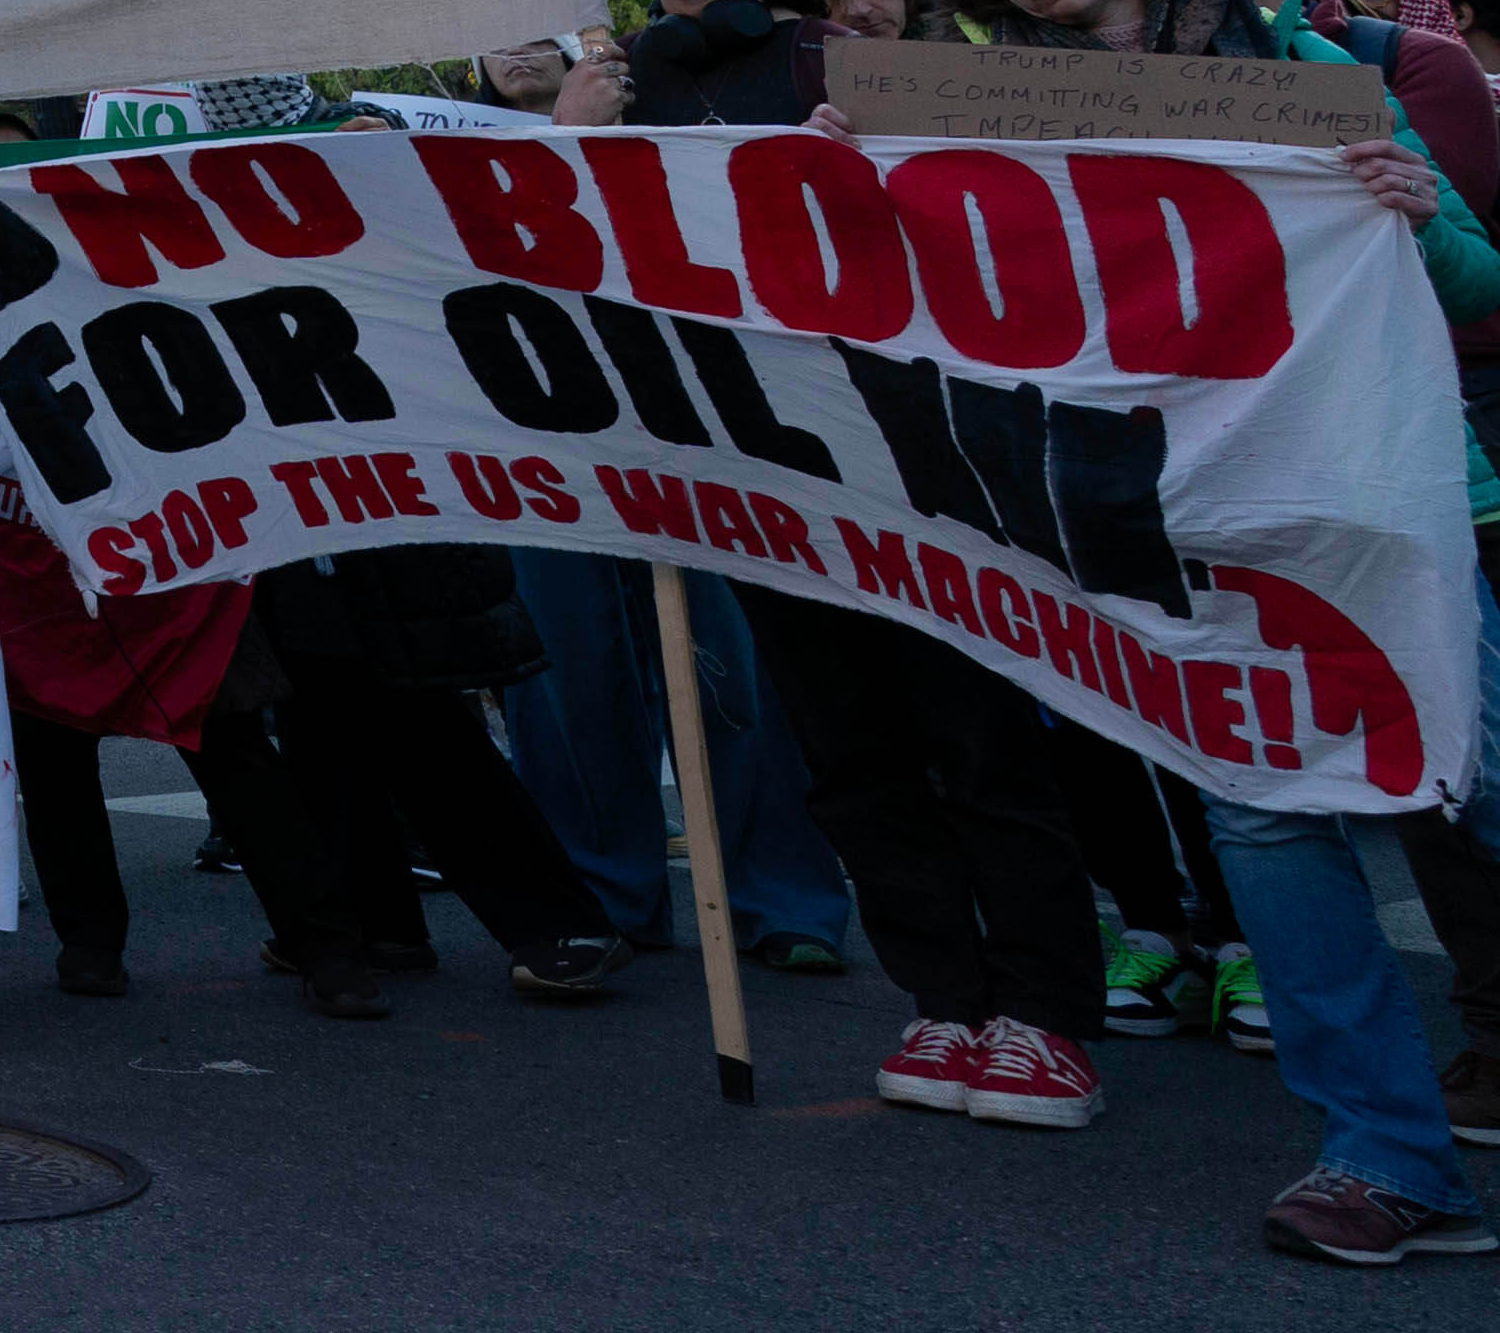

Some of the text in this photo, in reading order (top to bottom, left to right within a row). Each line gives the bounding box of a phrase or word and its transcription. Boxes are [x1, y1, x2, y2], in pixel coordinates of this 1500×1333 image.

[104, 100, 190, 139] NO
[853, 72, 1382, 133] HE'S COMMITTING WAR CRIMES!
[971, 49, 1300, 89] TRUMP IS CRAZY!
[30, 133, 1295, 381] NO BLOOD
[441, 282, 845, 484] OIL
[87, 464, 257, 599] STOP
[278, 451, 441, 532] THE
[445, 449, 583, 525] US
[594, 462, 829, 577] WAR
[834, 516, 1303, 771] MACHINE!
